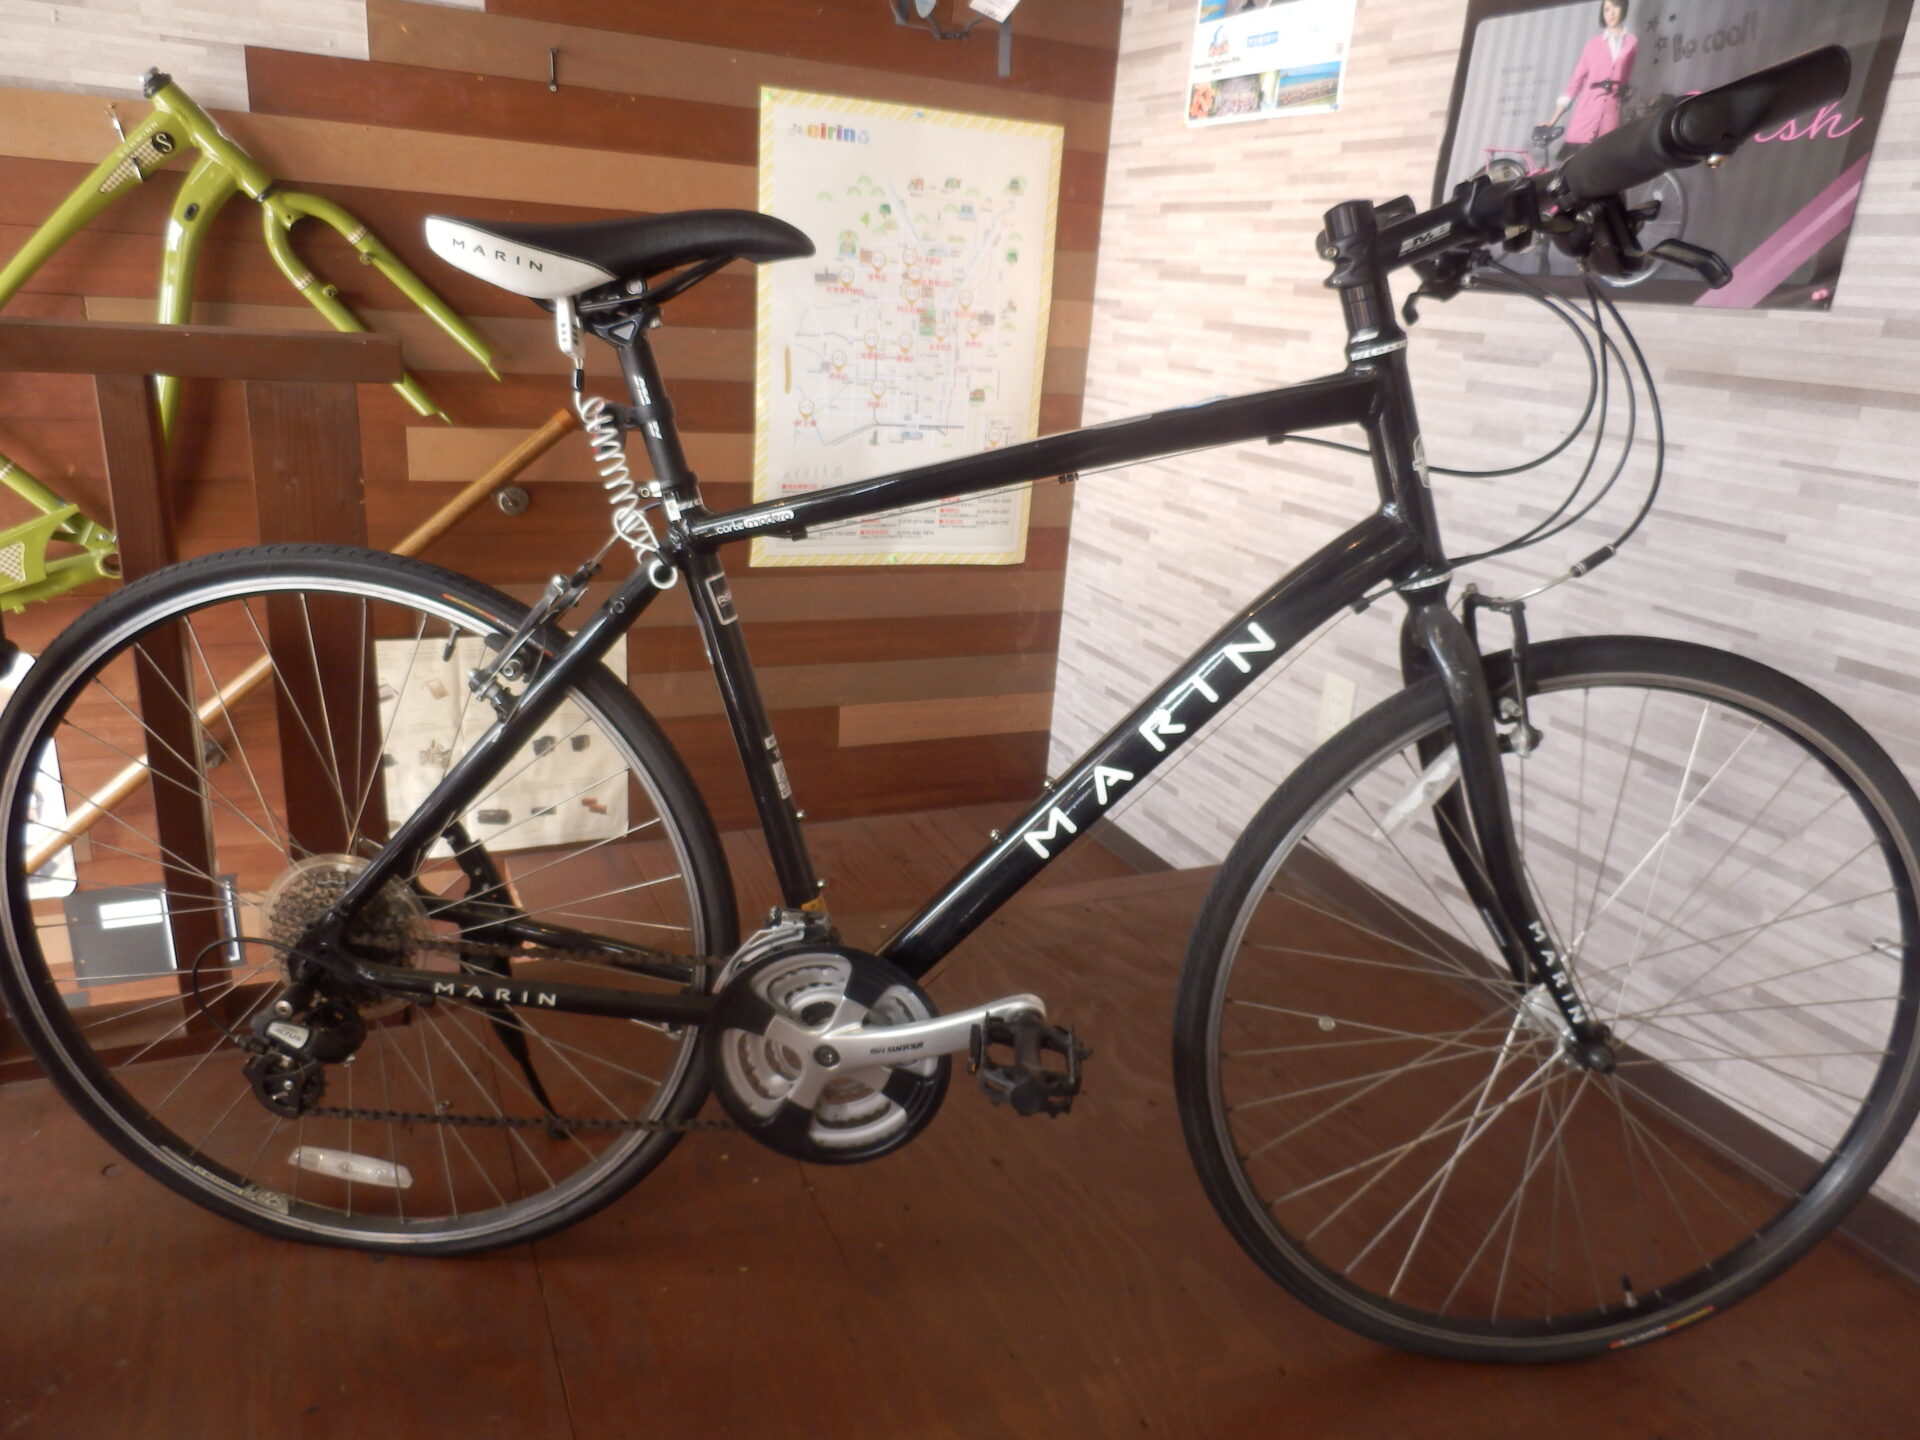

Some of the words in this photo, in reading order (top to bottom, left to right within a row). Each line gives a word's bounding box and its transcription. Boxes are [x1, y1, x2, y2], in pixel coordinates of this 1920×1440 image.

[1672, 33, 1698, 63] Be
[452, 238, 544, 273] MARIN
[716, 523, 744, 535] corte
[746, 511, 792, 529] madera
[1023, 621, 1276, 861] MARIN
[1528, 920, 1586, 1024] MARIN
[433, 981, 557, 1007] MARIN
